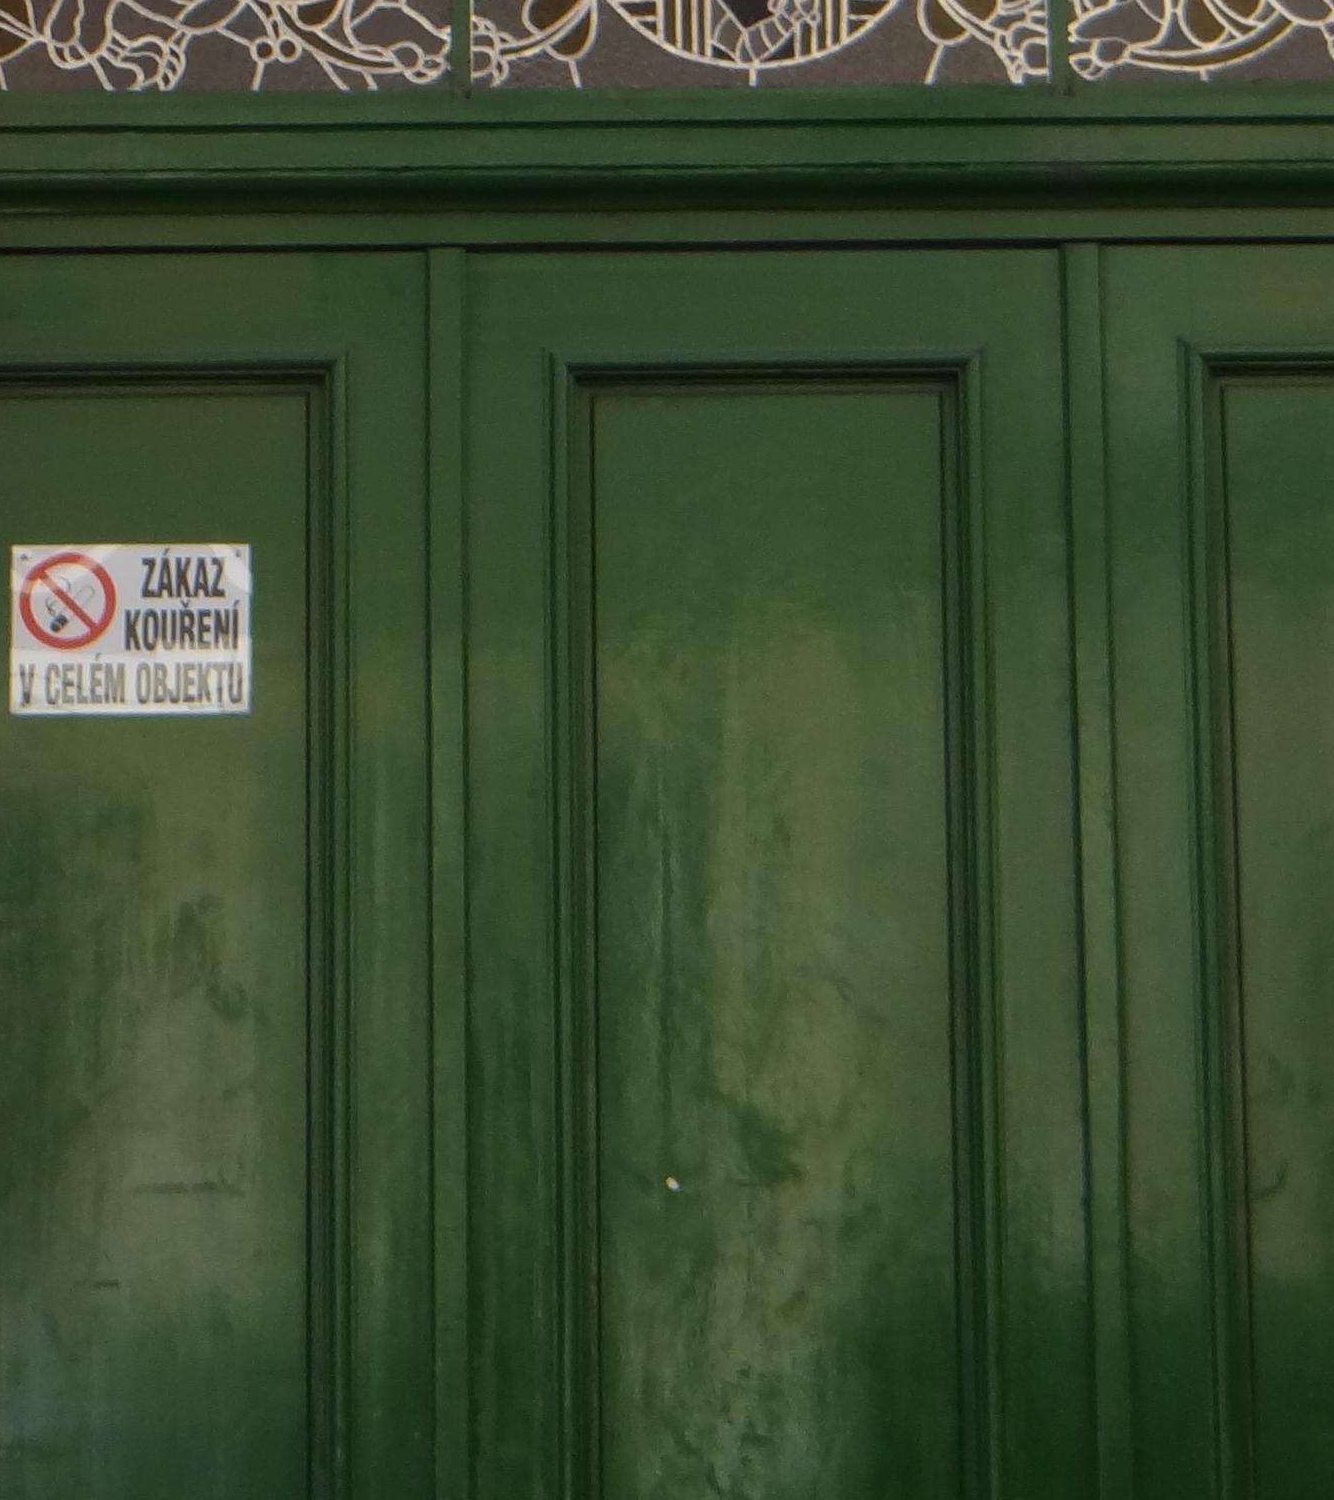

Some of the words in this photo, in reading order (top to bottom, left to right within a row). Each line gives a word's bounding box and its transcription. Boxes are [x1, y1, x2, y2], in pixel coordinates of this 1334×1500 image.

[141, 548, 226, 598] ZÁKAZ
[124, 600, 239, 651] KOUŘENÍ
[19, 663, 35, 705] V
[44, 653, 125, 705] CELÉM
[136, 661, 243, 705] OBJEKTU
